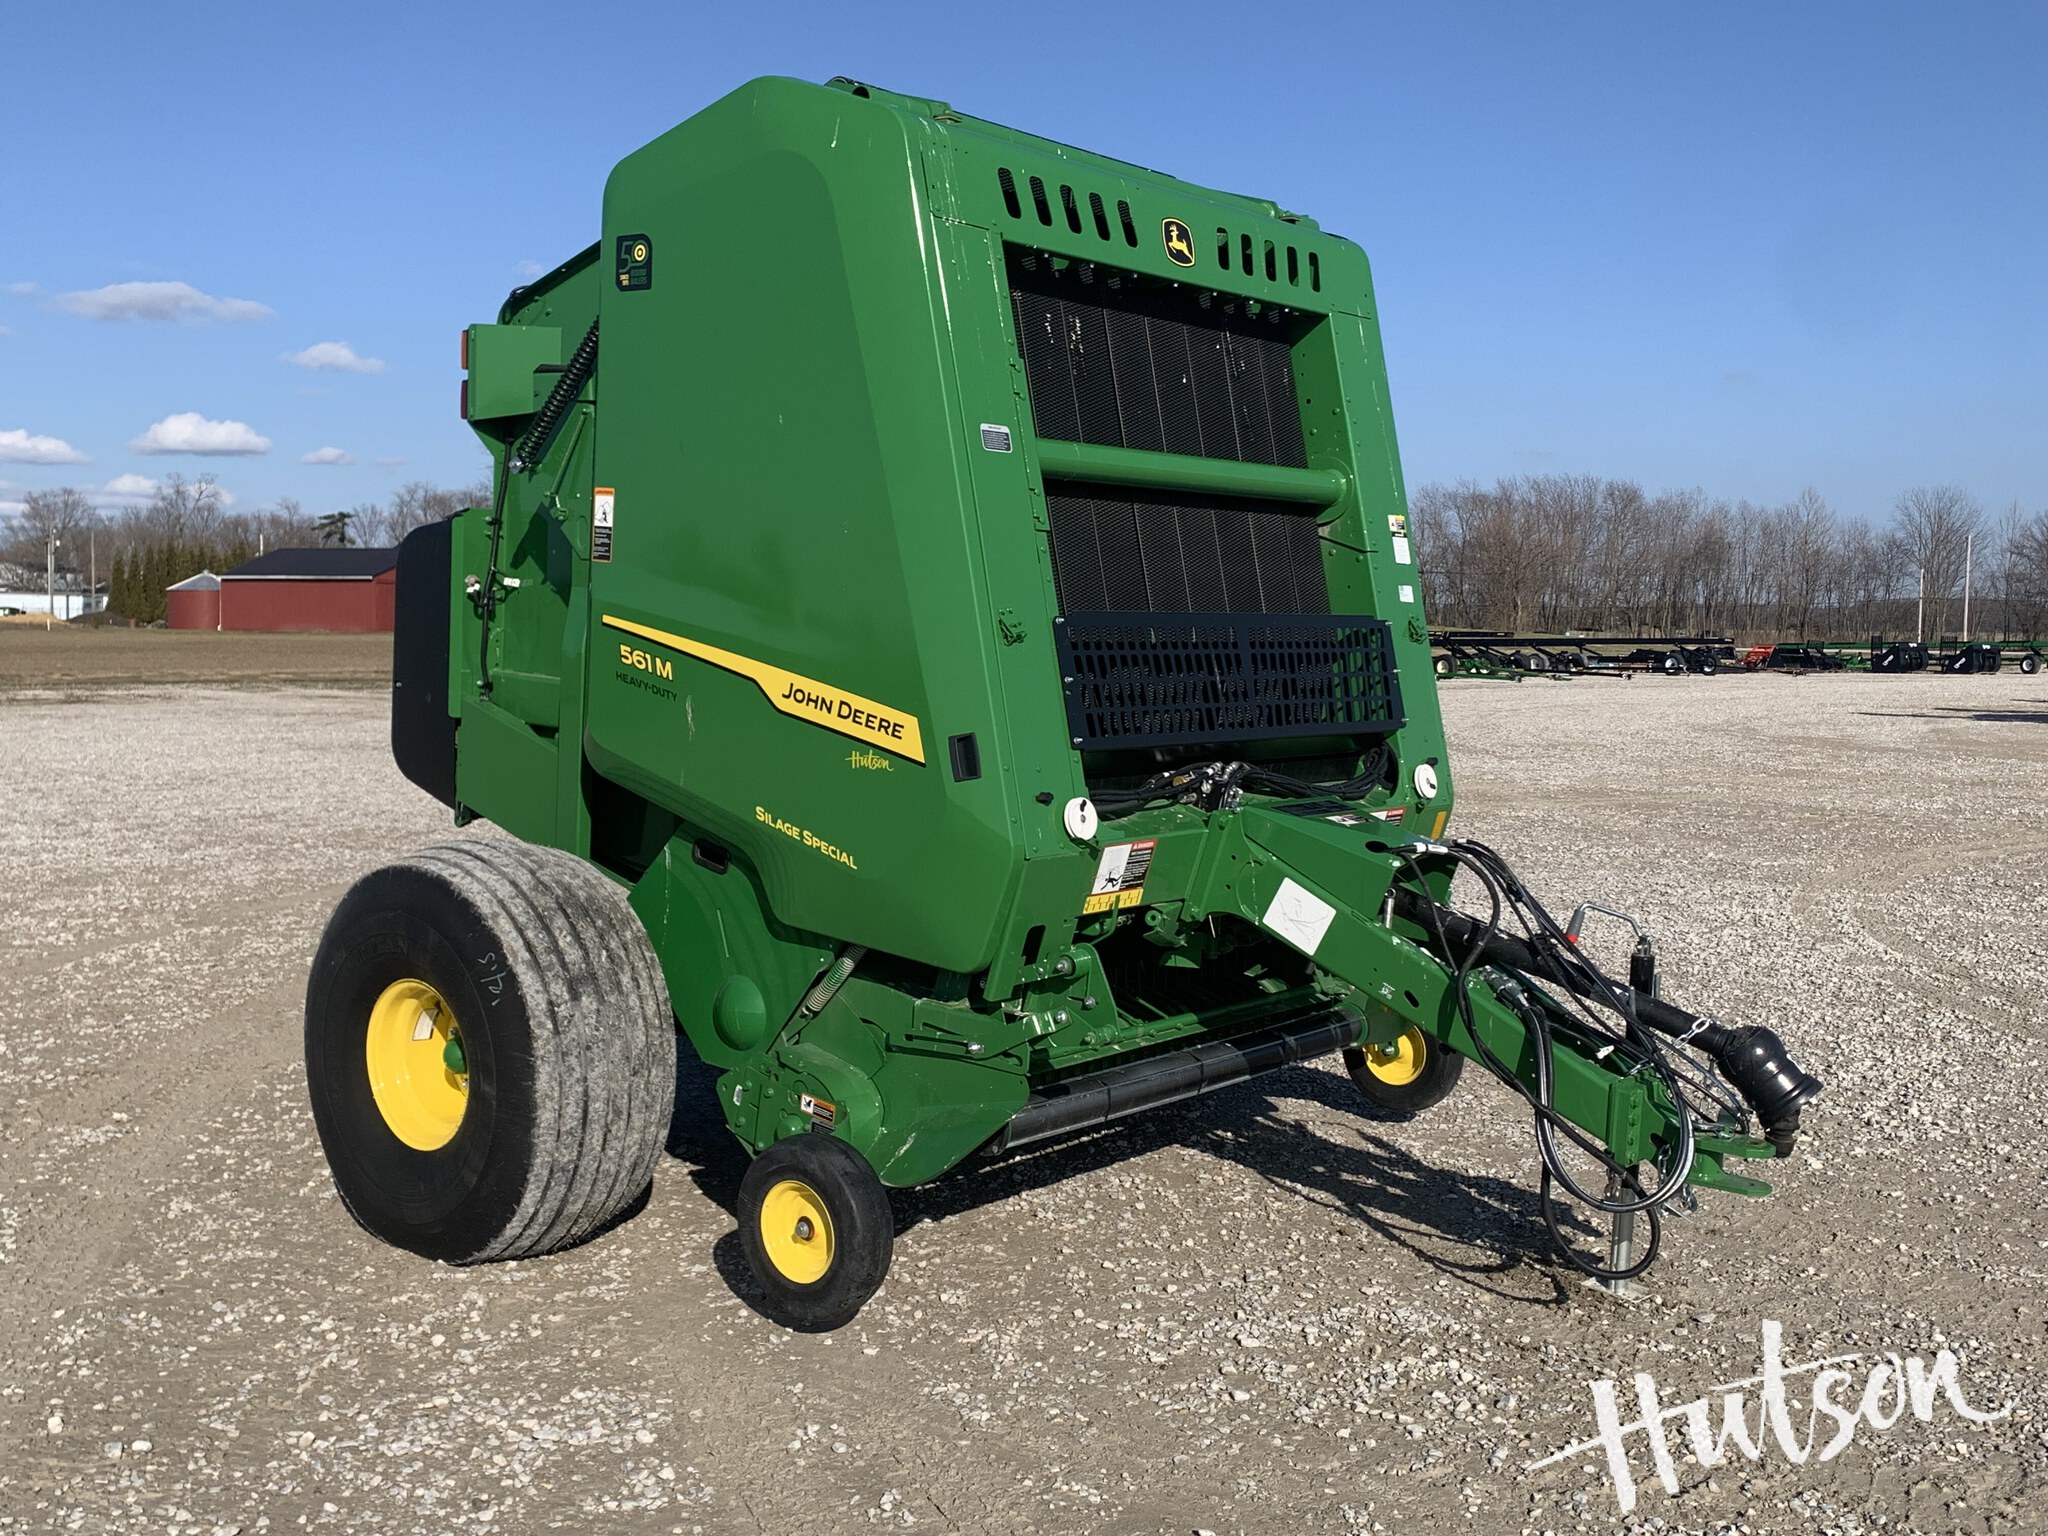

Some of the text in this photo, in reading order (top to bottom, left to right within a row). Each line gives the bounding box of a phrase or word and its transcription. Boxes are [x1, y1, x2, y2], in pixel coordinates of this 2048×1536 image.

[615, 670, 677, 702] HEAVY-DUTY
[782, 682, 904, 740] JOHN DEERE
[844, 749, 894, 771] Hutson
[755, 805, 858, 870] SILAGE SPECIAL
